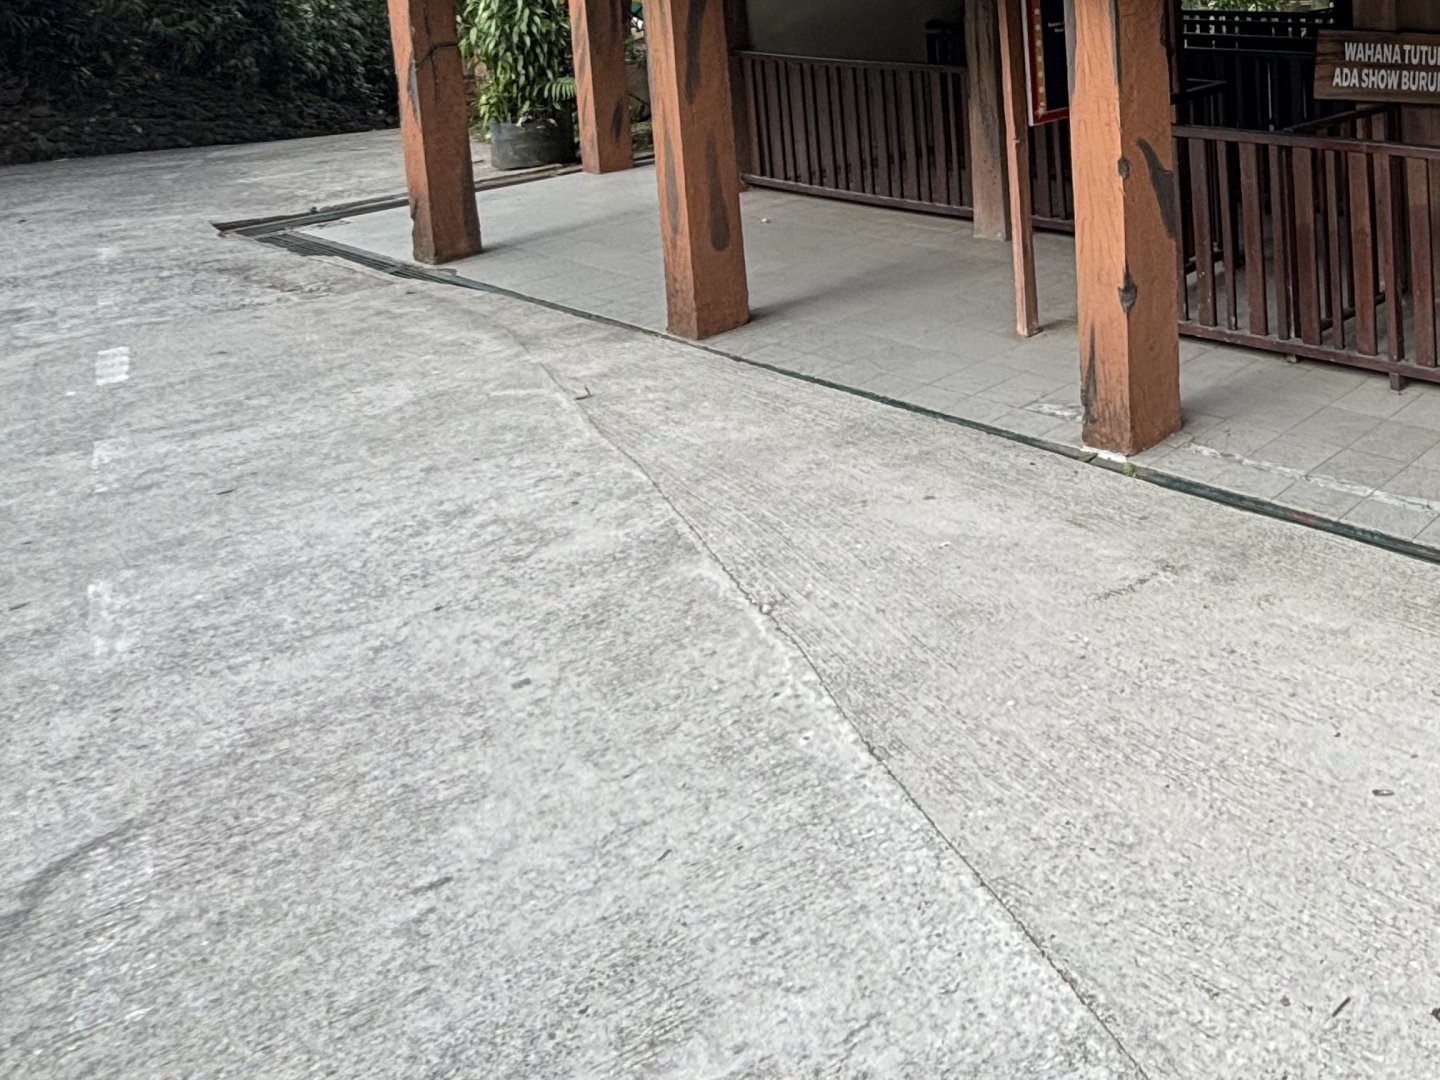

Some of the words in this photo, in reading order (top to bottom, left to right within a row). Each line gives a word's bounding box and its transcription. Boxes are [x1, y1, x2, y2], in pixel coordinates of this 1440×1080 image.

[1344, 41, 1401, 65] WAHANA
[1332, 67, 1359, 88] ADA
[1361, 69, 1399, 91] SHOW
